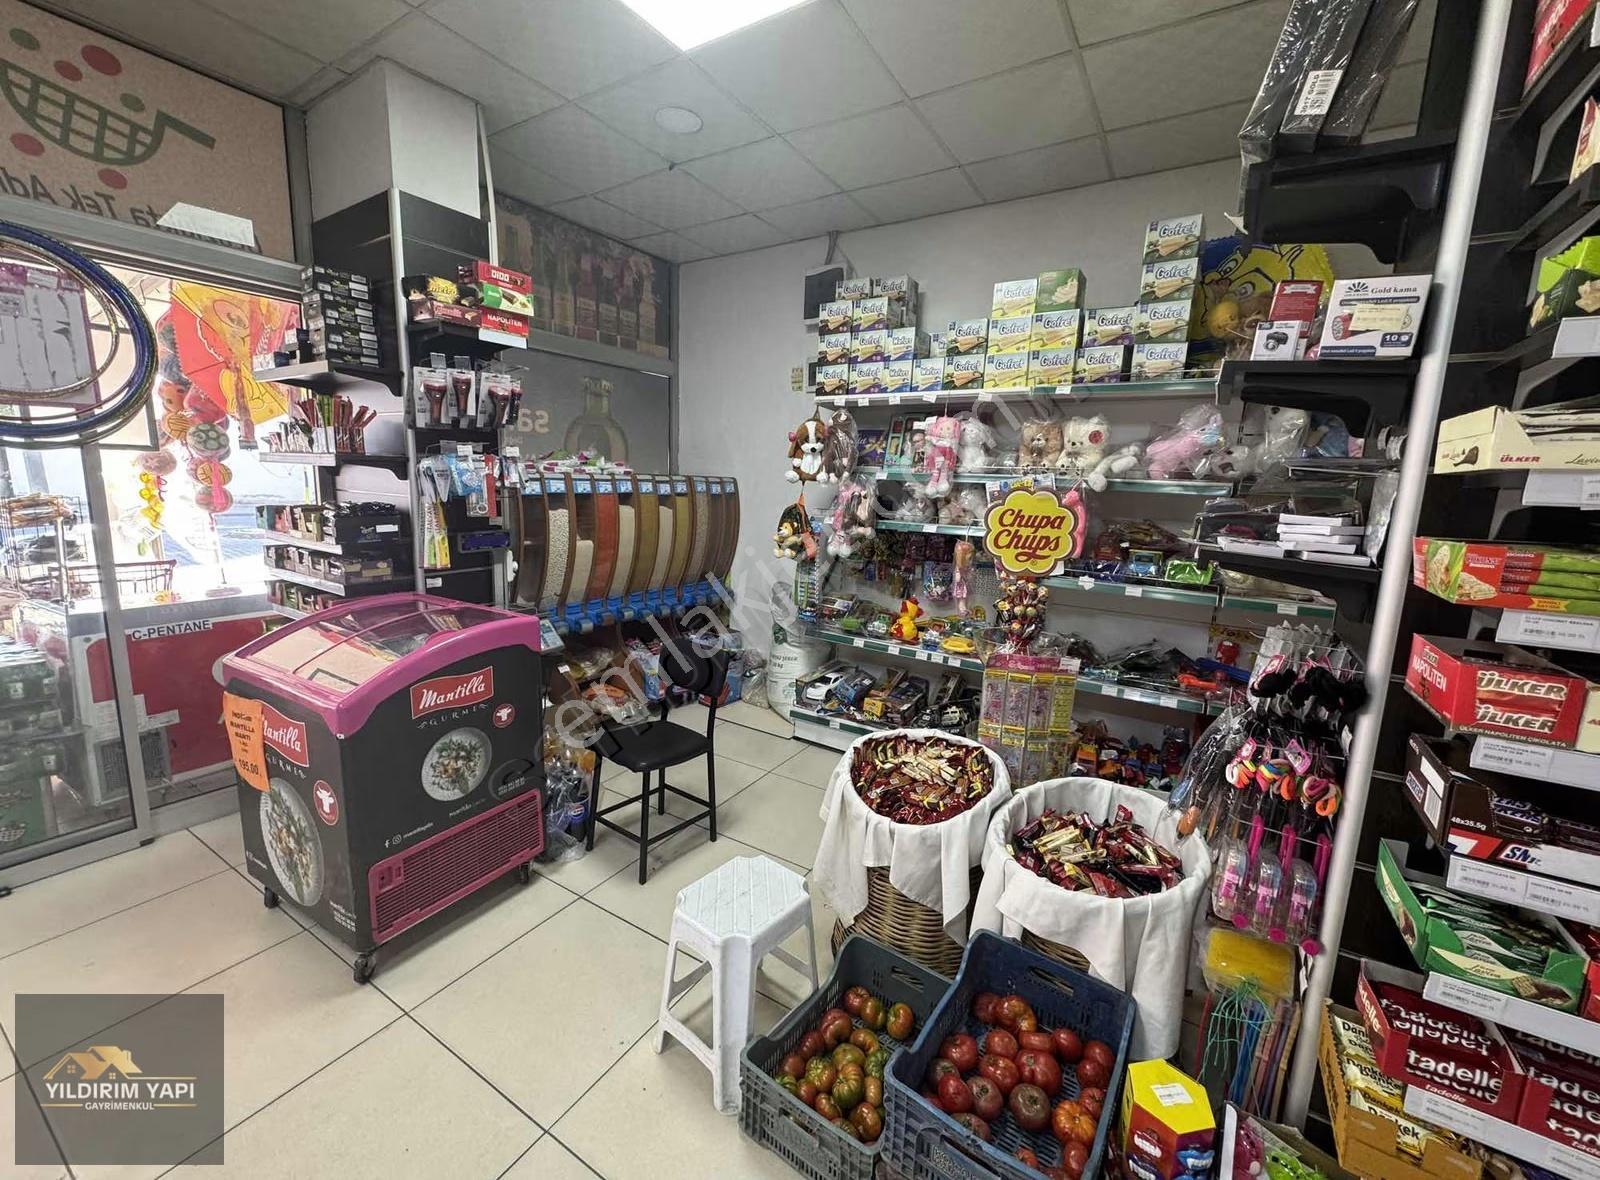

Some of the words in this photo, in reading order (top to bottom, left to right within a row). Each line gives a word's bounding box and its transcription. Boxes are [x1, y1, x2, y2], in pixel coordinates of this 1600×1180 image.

[1159, 222, 1197, 238] Gofret
[1156, 264, 1194, 279] Gofret
[1003, 284, 1034, 298] Gofret
[1371, 286, 1392, 294] Gold
[1394, 285, 1418, 293] kama
[1098, 313, 1133, 326] Gofret
[1150, 306, 1186, 320] Gofret
[1000, 323, 1029, 335] Gofret
[1043, 315, 1076, 329] Gofret
[956, 325, 983, 337] Gofret
[1385, 334, 1398, 342] 10
[1039, 353, 1071, 367] Gofret
[1086, 353, 1119, 366] Gofret
[1146, 347, 1184, 361] Gofret
[954, 360, 982, 371] Gofret
[995, 358, 1024, 371] Gofret
[1500, 454, 1541, 463] ÜLKER
[998, 508, 1067, 535] Chupa
[993, 529, 1062, 563] Chups
[131, 619, 212, 641] C-PENTANE
[419, 675, 486, 710] Mantilla
[1477, 671, 1568, 700] ÜLKER
[262, 715, 302, 753] antilla
[1407, 1047, 1504, 1092] tadelle
